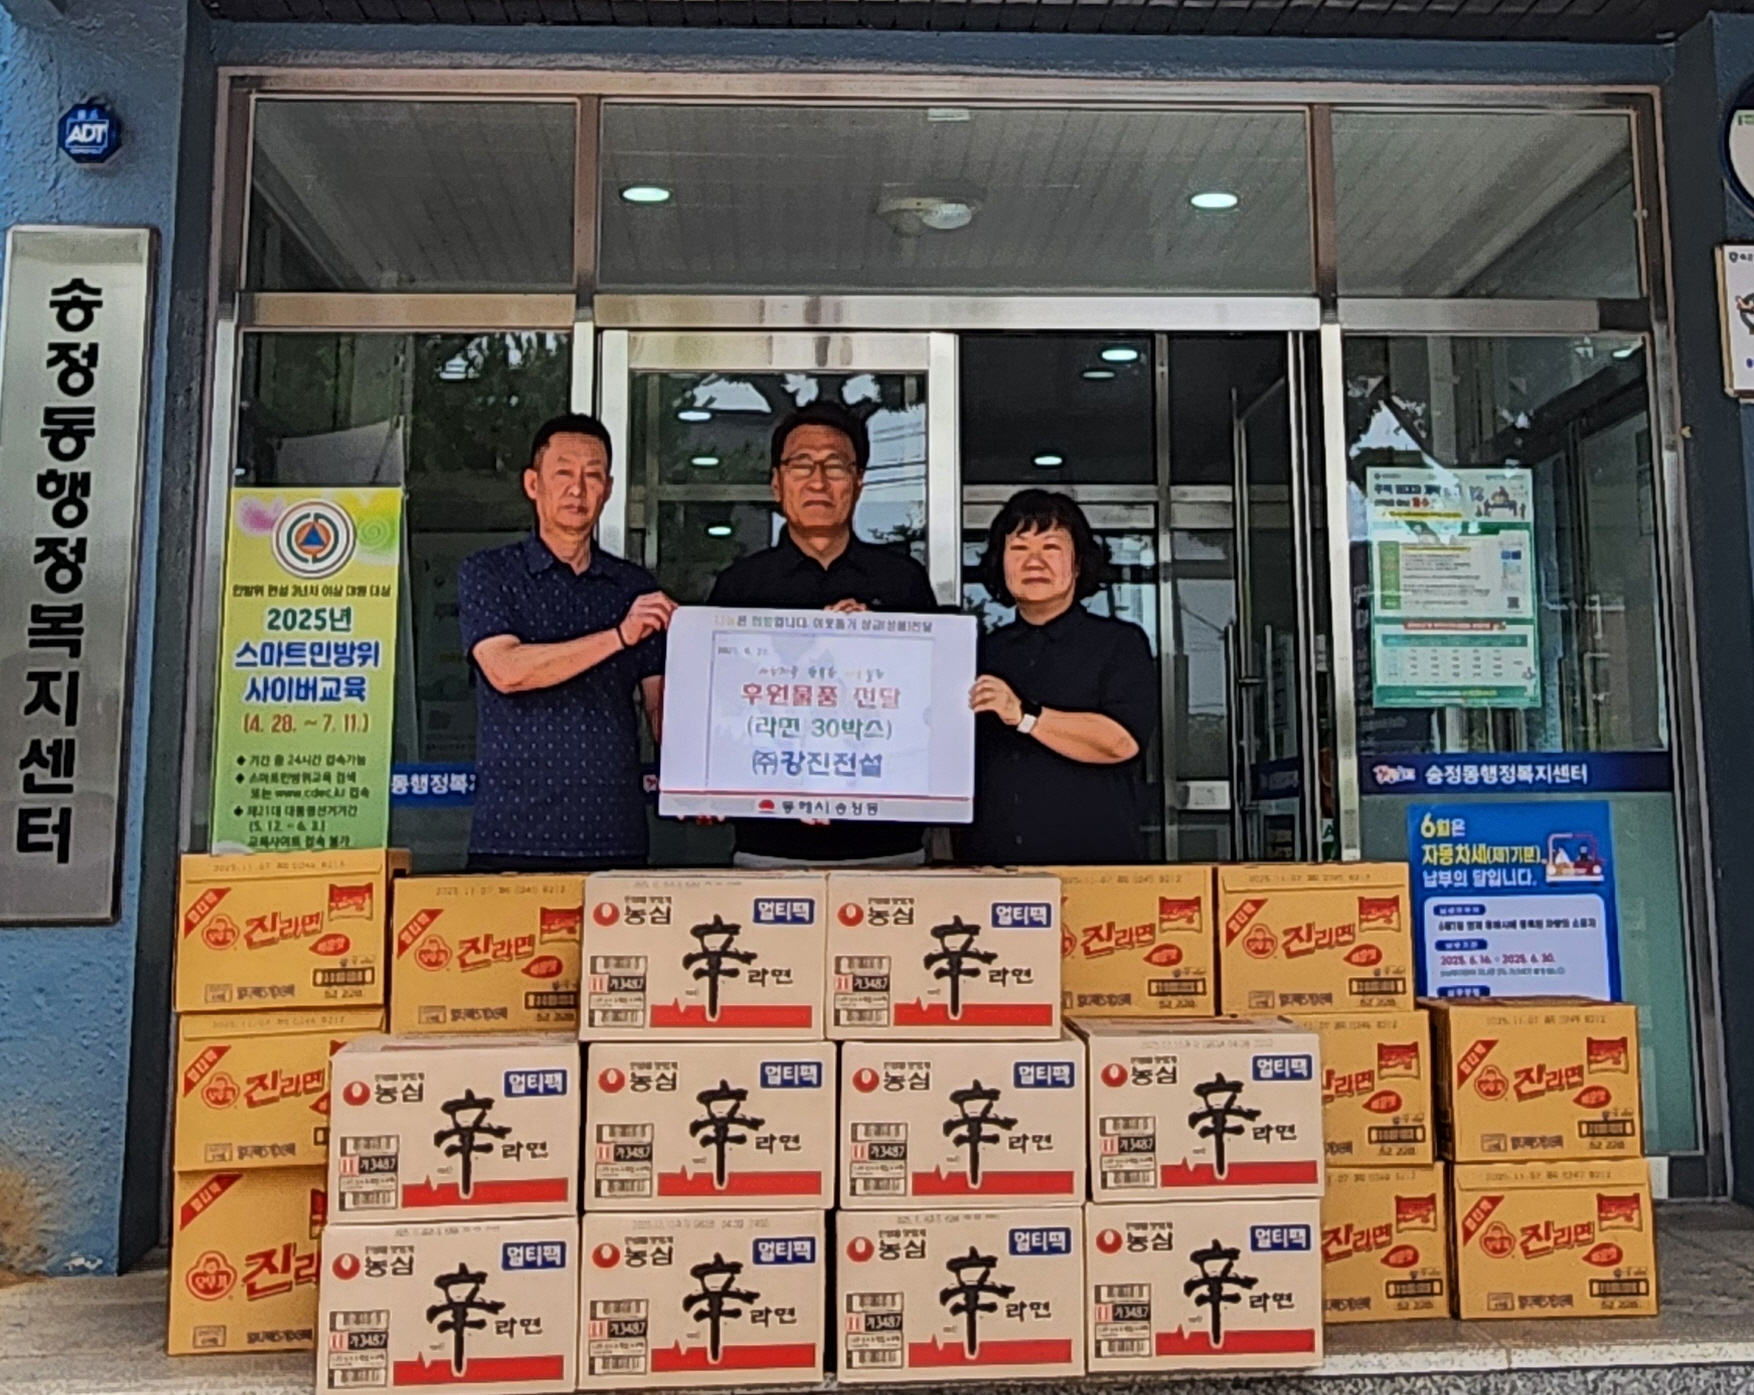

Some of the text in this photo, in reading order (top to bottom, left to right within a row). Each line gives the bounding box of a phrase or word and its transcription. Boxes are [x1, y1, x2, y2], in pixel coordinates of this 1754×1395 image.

[66, 123, 107, 143] ADT
[15, 277, 103, 865] 송정동행정복지센터
[267, 606, 351, 632] 2025년
[235, 640, 380, 667] 스마트민방위
[245, 676, 366, 703] 사이버교육
[244, 713, 263, 734] (4.
[271, 713, 297, 733] 28.
[323, 713, 335, 733] 7.
[344, 712, 369, 734] 11.)
[747, 715, 893, 742] (라면 30박스)
[1424, 763, 1589, 786] 송정동행정복지센터
[1420, 812, 1466, 838] 6월은
[1422, 868, 1538, 888] 납부의 달입니다.
[624, 905, 672, 925] 농심
[759, 902, 809, 920] 멀티팩
[868, 906, 914, 926] 농심
[997, 906, 1046, 924] 멀티팩
[244, 910, 324, 950] 진라면
[1080, 922, 1156, 959] 진라면
[1283, 922, 1356, 959] 진라면
[457, 934, 535, 973] 진라면
[683, 914, 758, 1018] 辛
[747, 967, 793, 987] 라면
[924, 915, 999, 1017] 辛
[988, 967, 1034, 986] 라면
[765, 1065, 817, 1084] 멀티팩
[1019, 1066, 1069, 1084] 멀티팩
[1131, 1065, 1178, 1086] 농심
[1258, 1059, 1307, 1077] 멀티팩
[243, 1069, 326, 1108] 진라면
[509, 1073, 562, 1093] 멀티팩
[630, 1072, 677, 1093] 농심
[883, 1071, 930, 1092] 농심
[1513, 1063, 1584, 1102] 진라면
[375, 1083, 424, 1105] 농심
[690, 1079, 765, 1186] 辛
[942, 1080, 1018, 1185] 辛
[1187, 1073, 1262, 1176] 辛
[1252, 1123, 1297, 1143] 라면
[435, 1089, 512, 1196] 辛
[501, 1141, 549, 1161] 라면
[755, 1133, 802, 1153] 라면
[1008, 1133, 1053, 1152] 라면
[1015, 1232, 1065, 1252] 멀티팩
[1127, 1232, 1174, 1253] 농심
[1256, 1229, 1305, 1247] 멀티팩
[1322, 1223, 1393, 1264] 진라면
[1519, 1221, 1595, 1260] 진라면
[508, 1246, 560, 1266] 멀티팩
[625, 1245, 674, 1267] 농심
[759, 1241, 810, 1261] 멀티팩
[879, 1239, 926, 1261] 농심
[242, 1242, 321, 1300] 진라
[365, 1255, 414, 1277] 농심
[940, 1246, 1016, 1356] 辛
[1184, 1240, 1259, 1345] 辛
[1249, 1292, 1295, 1311] 라면
[426, 1262, 506, 1373] 辛
[683, 1252, 761, 1362] 辛
[750, 1306, 797, 1326] 라면
[1005, 1301, 1052, 1321] 라면
[495, 1317, 543, 1337] 라면
